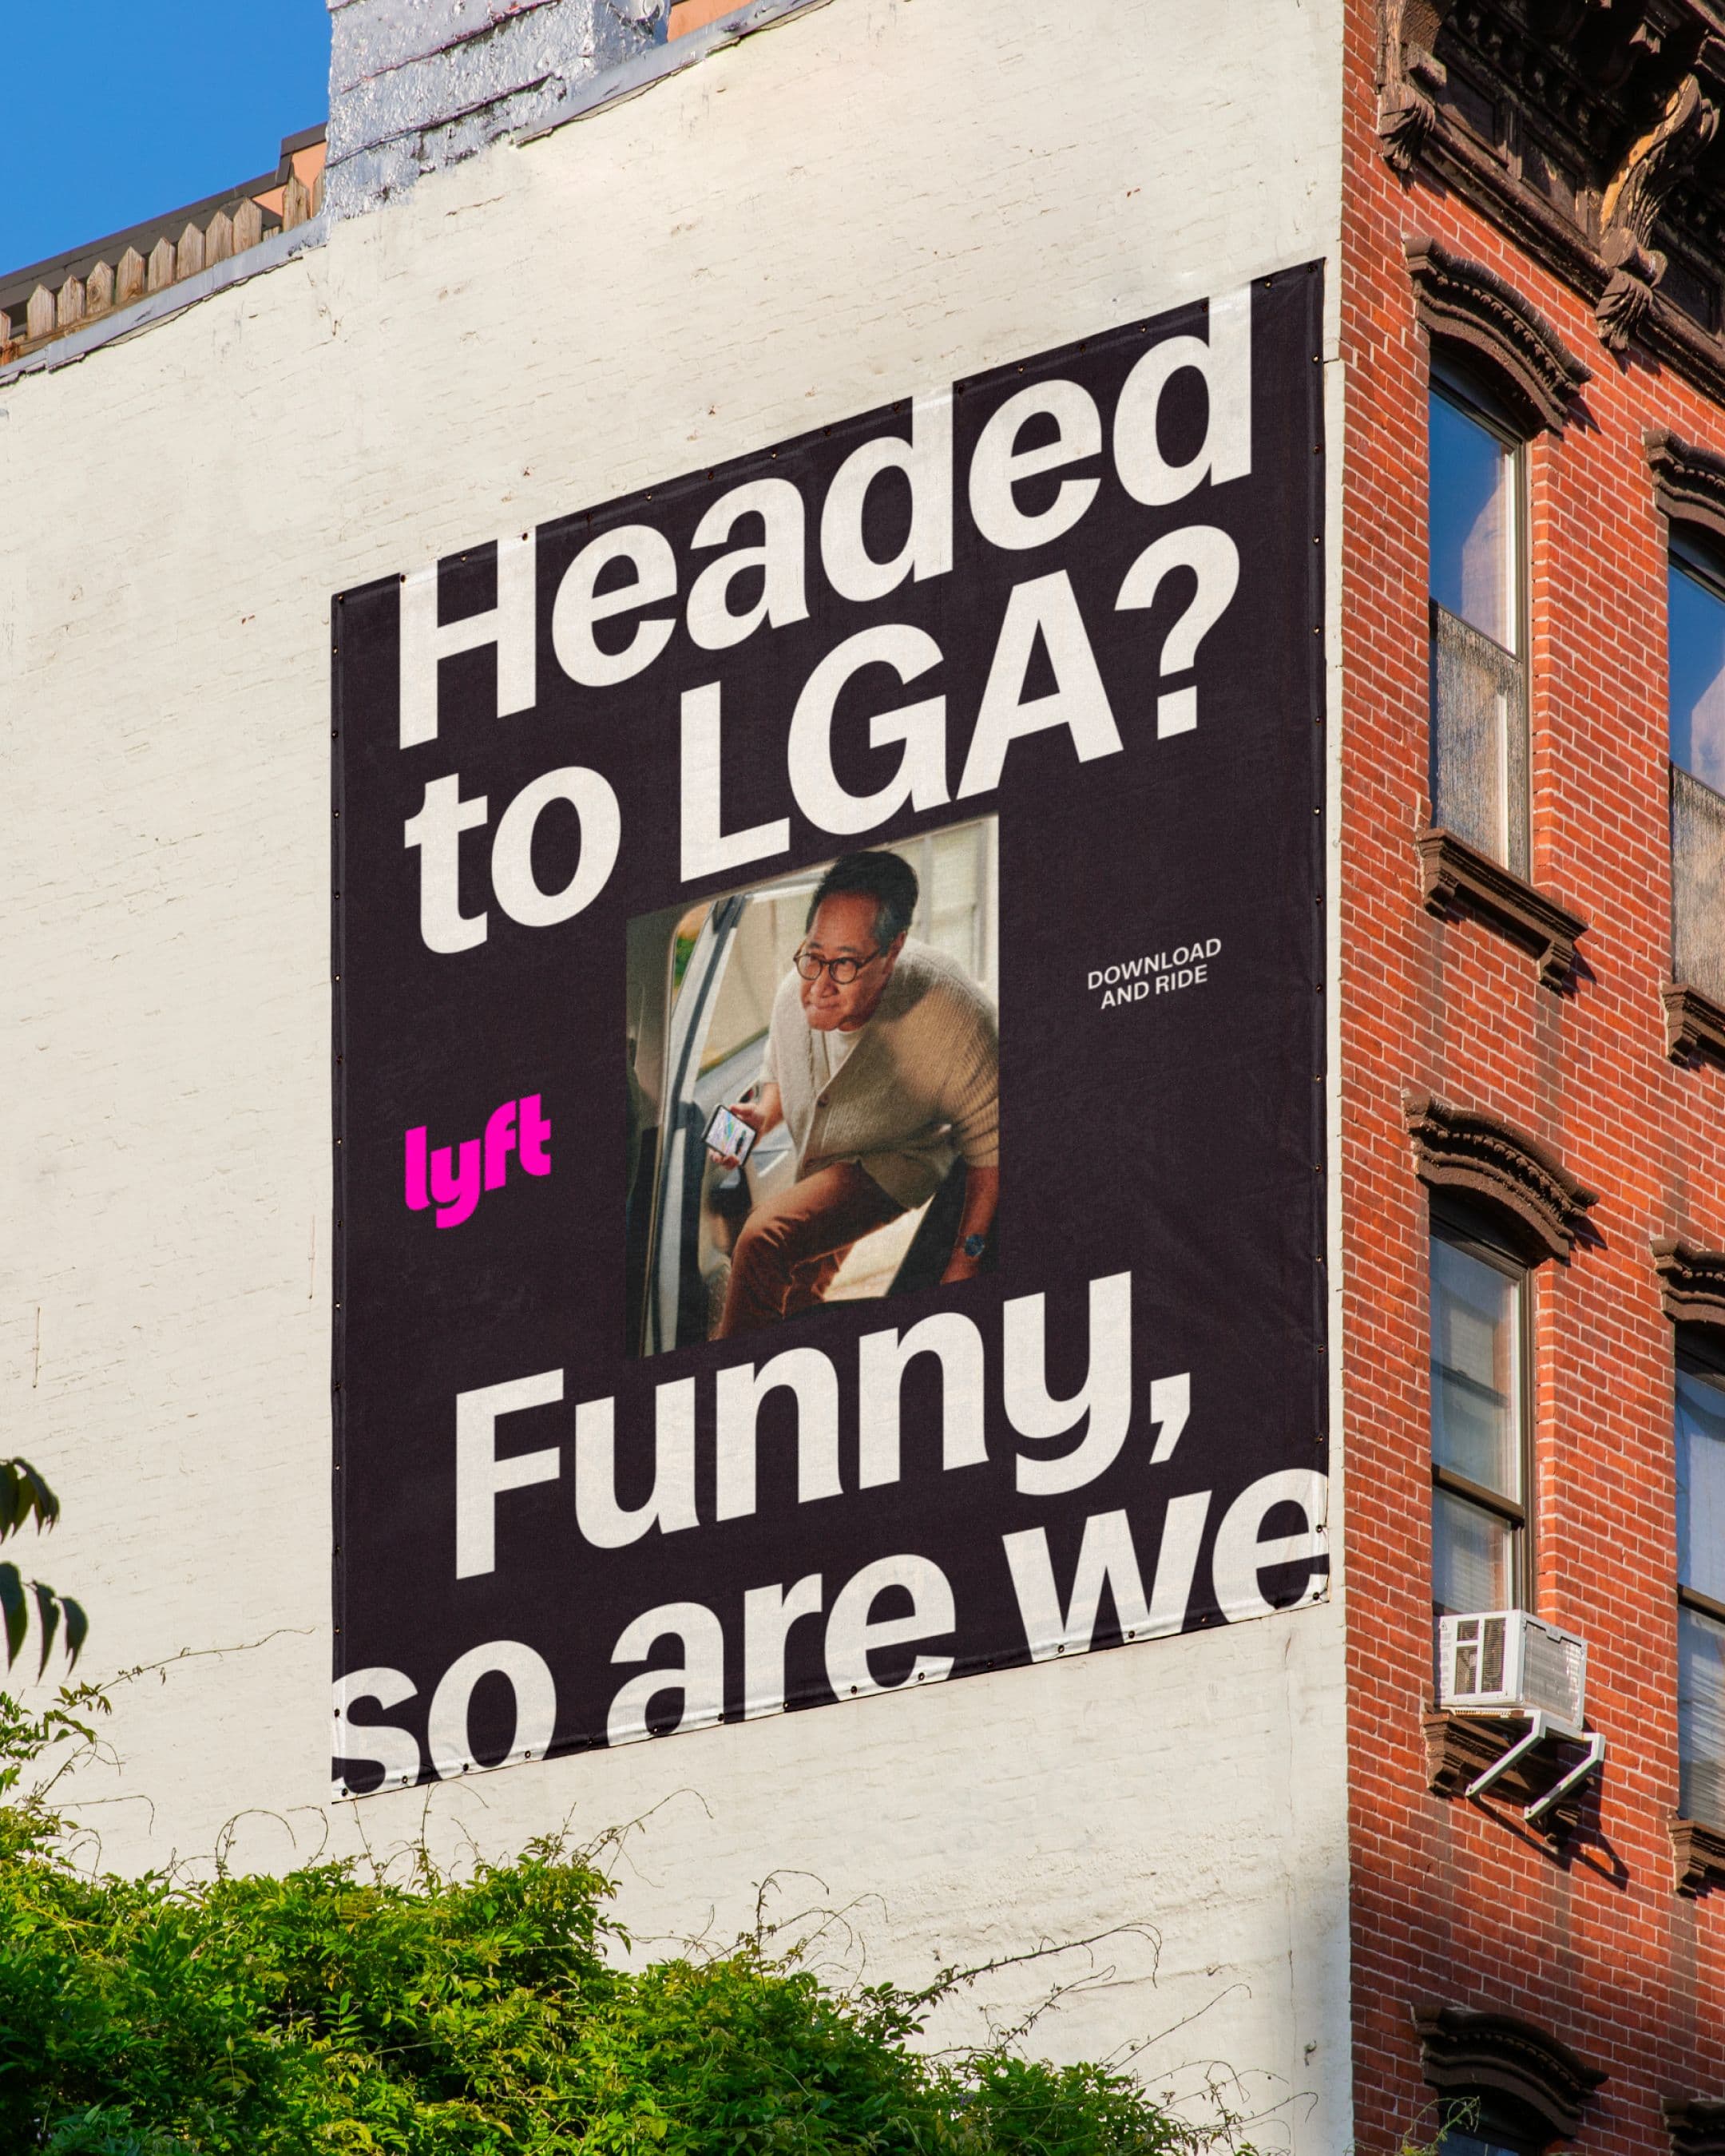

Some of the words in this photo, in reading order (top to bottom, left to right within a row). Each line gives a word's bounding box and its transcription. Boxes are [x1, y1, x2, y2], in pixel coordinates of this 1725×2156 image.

[399, 281, 1253, 749] Headed
[405, 767, 621, 954] to
[681, 525, 1240, 883] LGA?
[1088, 938, 1222, 990] DOWNLOAD
[1101, 981, 1149, 1009] AND
[1156, 964, 1208, 995] RIDE
[405, 1094, 551, 1229] lyft
[457, 1271, 1191, 1579] Funny,
[332, 1640, 557, 1801] so
[607, 1555, 955, 1746] are
[1002, 1468, 1329, 1663] we
